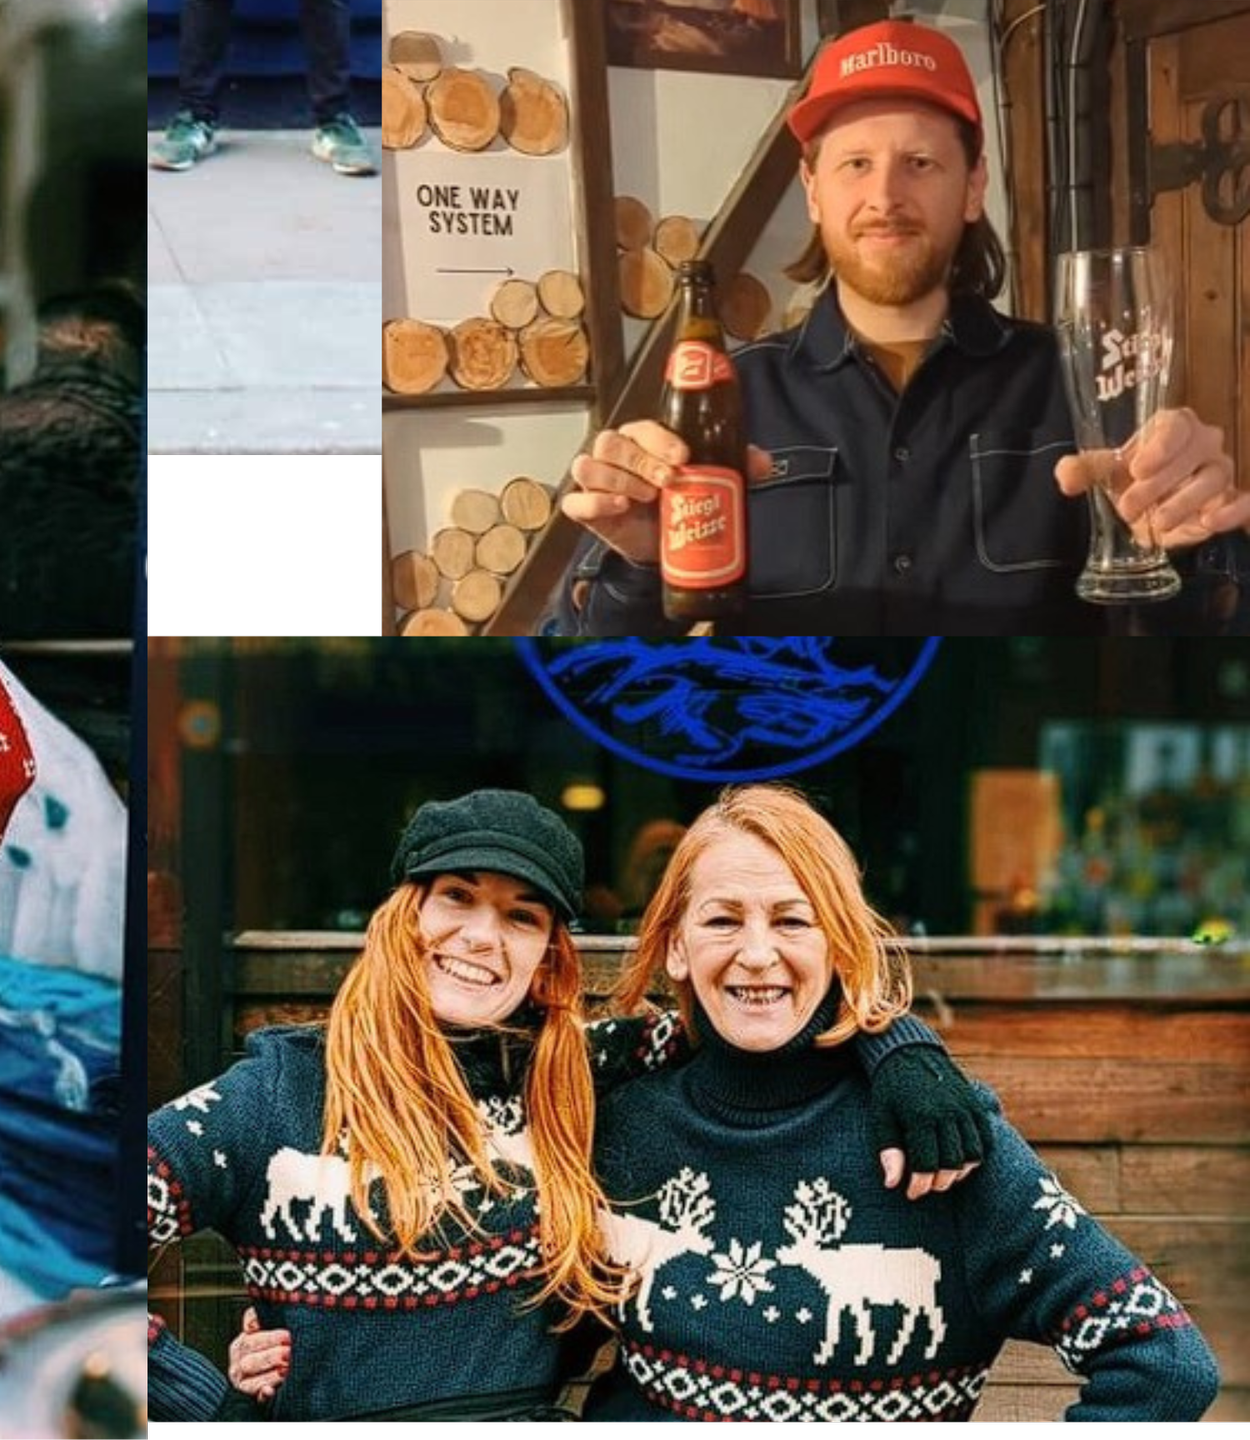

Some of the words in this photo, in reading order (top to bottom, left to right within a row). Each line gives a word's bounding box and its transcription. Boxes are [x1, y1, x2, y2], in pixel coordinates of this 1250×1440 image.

[838, 41, 938, 76] Marlboro
[416, 183, 463, 210] ONE
[468, 186, 520, 212] WAY
[429, 209, 514, 237] SYSTEM
